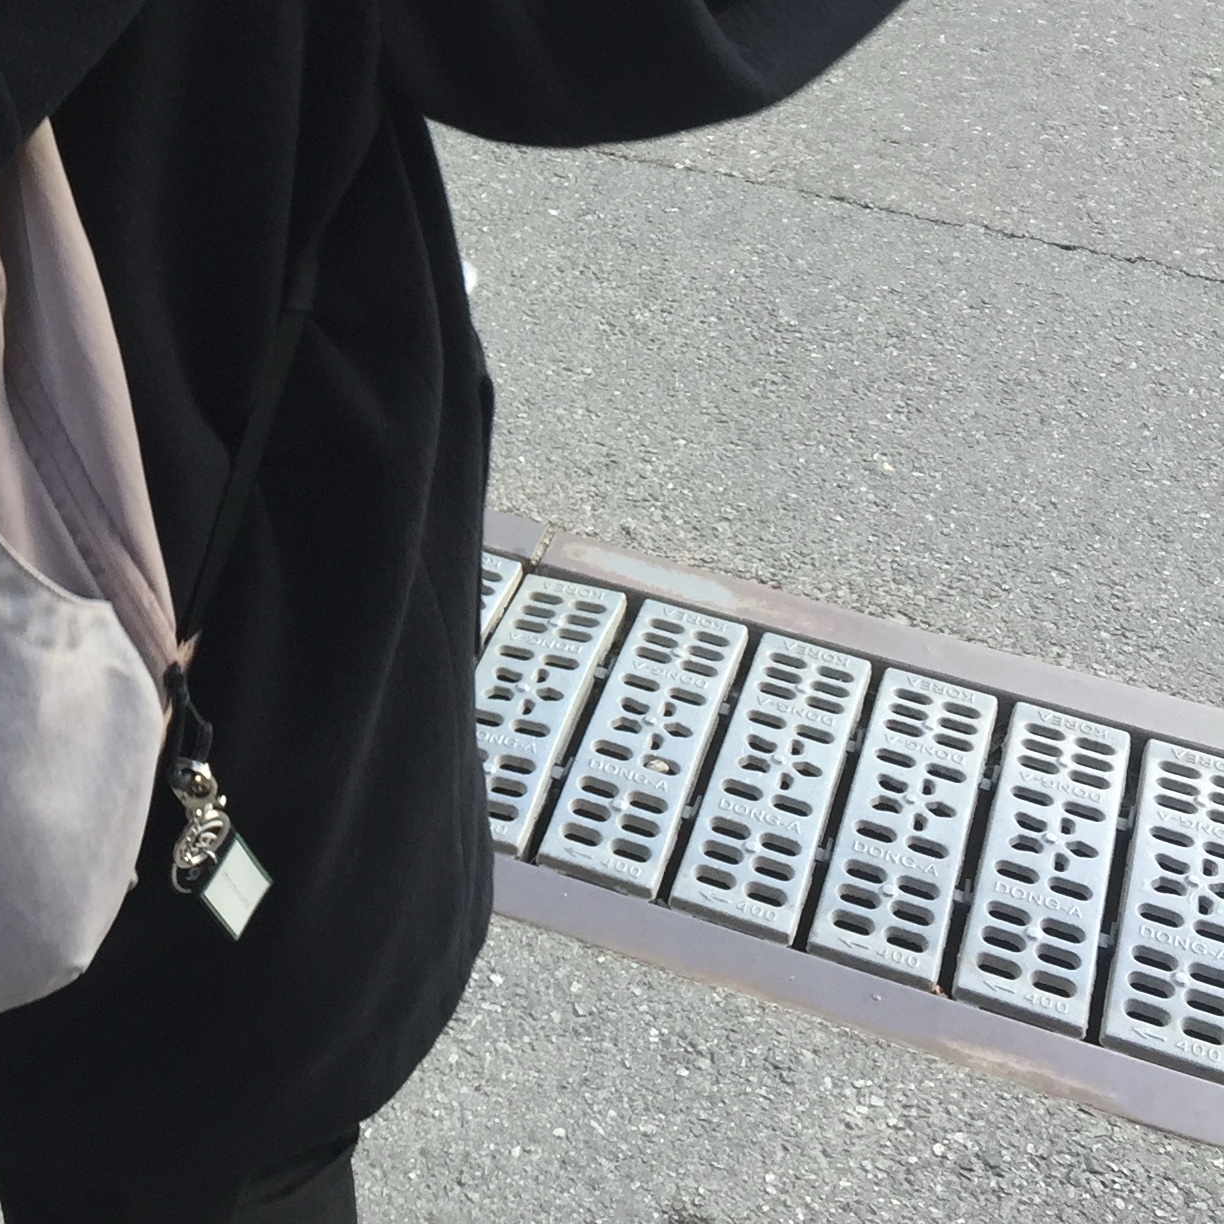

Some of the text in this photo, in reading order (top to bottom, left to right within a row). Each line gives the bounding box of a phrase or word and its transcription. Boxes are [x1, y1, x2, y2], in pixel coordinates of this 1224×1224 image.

[662, 607, 728, 633] KOREA
[784, 640, 850, 667] KOREA
[632, 660, 709, 688] DONG-A
[907, 676, 976, 702] KOREA
[756, 696, 834, 726] DONG-A
[1038, 711, 1109, 739] KOREA
[476, 730, 537, 754] ONG-A
[884, 733, 966, 765] DONG-A
[1171, 747, 1224, 773] OREA
[588, 758, 668, 791] DONG-A
[1019, 771, 1103, 803] DONG-A
[718, 798, 802, 834] DONG-A
[1157, 810, 1224, 839] ONG-A
[600, 857, 642, 879] 400
[853, 840, 939, 876] DONG-A
[736, 902, 777, 922] 400
[994, 881, 1083, 918] DONG-A
[877, 949, 921, 969] 400
[1024, 993, 1069, 1015] 400
[1176, 1040, 1222, 1063] 400
